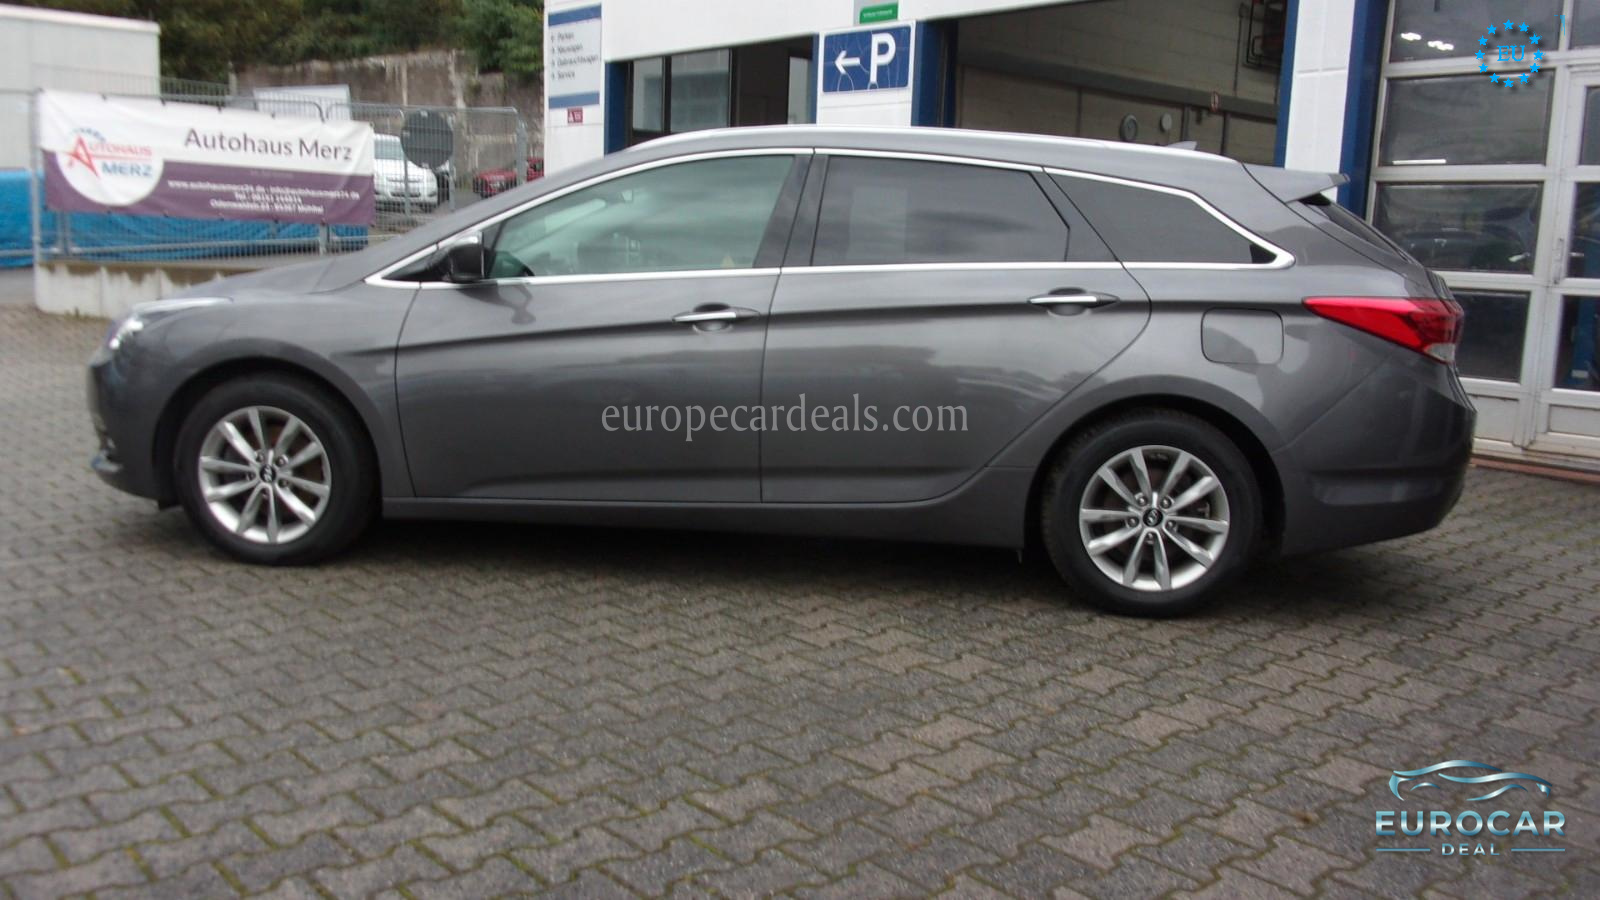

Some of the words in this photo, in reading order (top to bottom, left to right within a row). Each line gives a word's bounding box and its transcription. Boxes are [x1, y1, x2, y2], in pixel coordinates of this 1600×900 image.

[870, 32, 896, 84] P
[184, 128, 293, 155] Autohaus
[299, 139, 353, 161] Merz
[102, 162, 153, 177] MERZ
